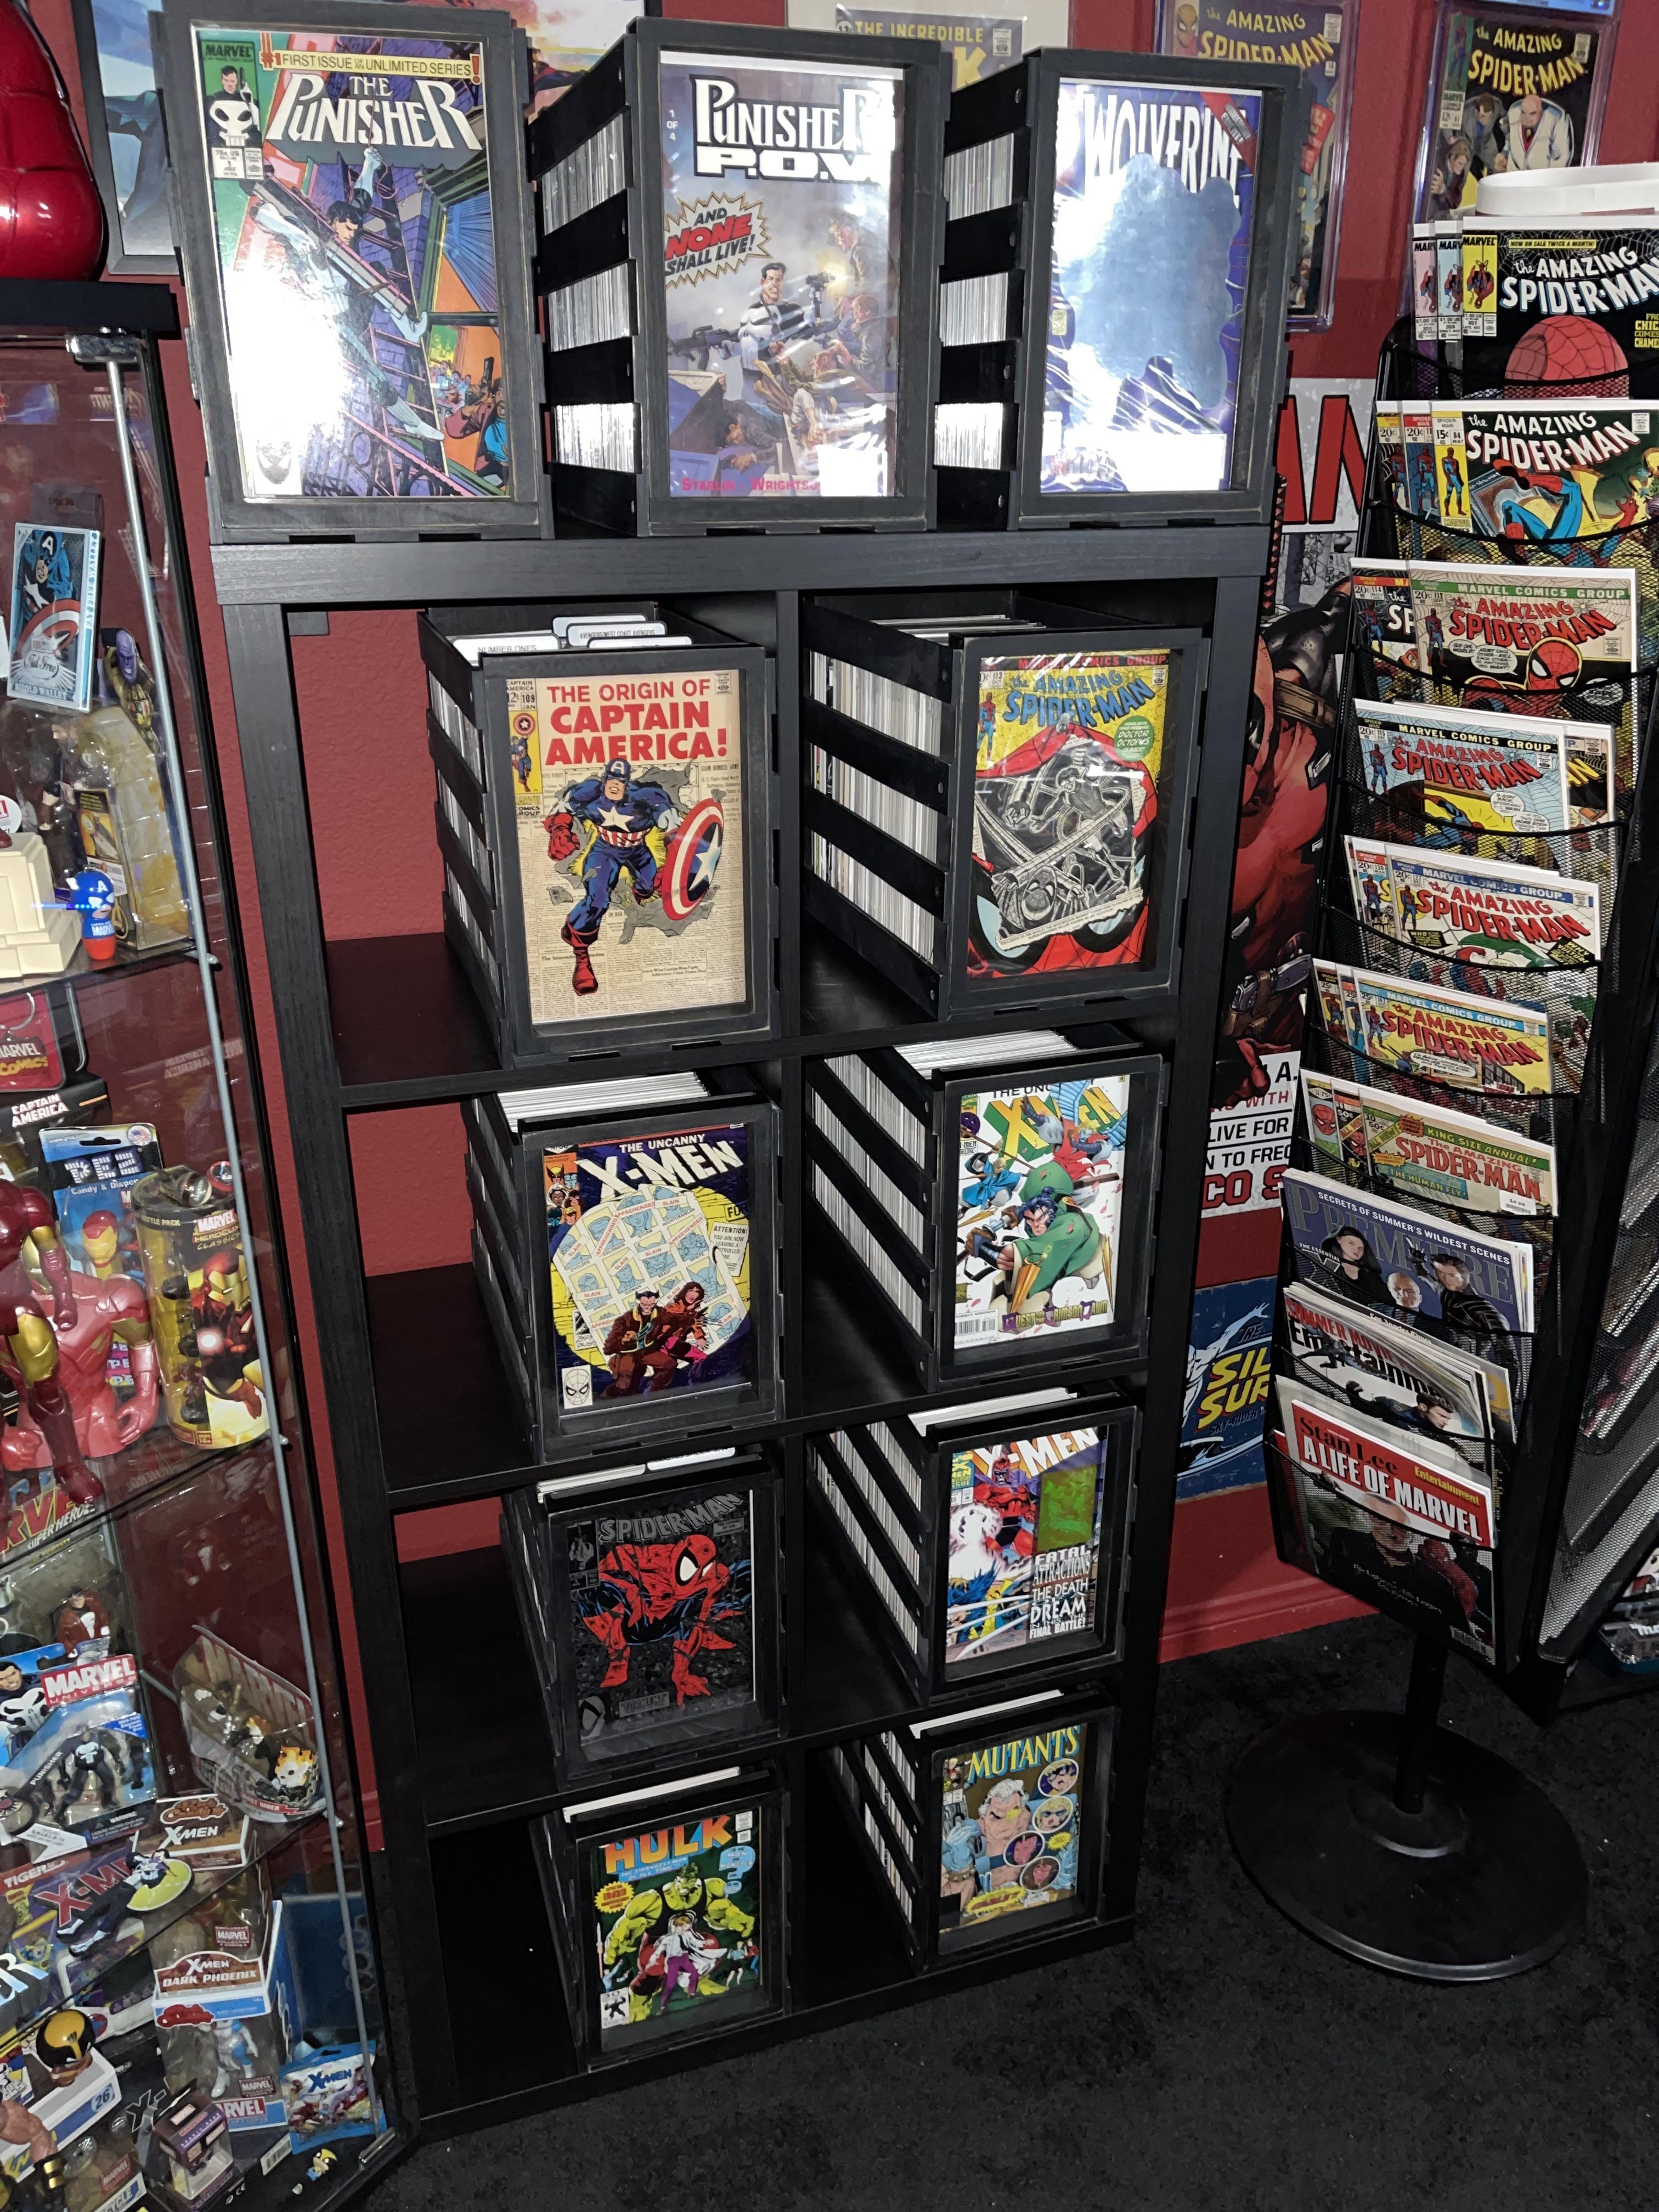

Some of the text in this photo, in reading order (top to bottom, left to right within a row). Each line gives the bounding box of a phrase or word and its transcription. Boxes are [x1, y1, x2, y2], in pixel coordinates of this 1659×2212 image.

[890, 21, 983, 43] INCREDIBLE
[1226, 9, 1306, 33] AMAZING
[206, 44, 252, 58] MARVEL
[1493, 28, 1562, 54] AMAZING
[282, 55, 317, 67] FIRST
[318, 57, 352, 69] ISSUE
[365, 59, 427, 74] UNLIMITED
[1468, 49, 1585, 96] SPIDER-MAN
[349, 76, 393, 97] THE
[267, 74, 483, 150] PUNISHER
[666, 121, 678, 129] OF
[693, 207, 727, 227] AND
[665, 213, 753, 261] NONE
[1463, 236, 1495, 246] MARVEL
[665, 235, 756, 276] SHALL LIVE!
[1514, 246, 1637, 278] the AMAZING
[1436, 430, 1449, 439] 15¢
[1467, 412, 1597, 435] the AMAZING
[1466, 421, 1641, 472] SPIDER-MAN
[1388, 591, 1407, 602] the
[1458, 584, 1625, 599] MARVEL COMICS GROUP
[1477, 597, 1574, 620] AMAZING
[1448, 609, 1617, 651] SPIDER-MAN
[515, 644, 537, 652] ONES
[1127, 655, 1166, 665] GROUP
[992, 672, 1002, 680] 113
[1034, 670, 1122, 693] AMAZING
[522, 694, 535, 703] 109
[546, 679, 711, 704] THE ORIGIN OF
[1003, 678, 1155, 728] SPIDER-MAN
[550, 701, 710, 735] CAPTAIN
[545, 728, 727, 766] AMERICA!
[1116, 737, 1150, 747] OCTOPUS
[1399, 724, 1446, 739] MARVEL
[1451, 732, 1499, 746] COMICS
[1507, 739, 1552, 752] GROUP
[1416, 738, 1504, 763] AMAZING
[1392, 747, 1543, 790] SPIDER-MAN
[1423, 868, 1468, 885] MARVEL
[1520, 886, 1564, 900] GROUP
[1428, 881, 1554, 915] the AMAZING
[1416, 890, 1591, 944] SPIDER-MAN
[1387, 992, 1515, 1028] MARVEL COMICS GROUP
[1413, 1009, 1508, 1042] AMAZING
[1382, 1010, 1543, 1066] SPIDER-MAN
[0, 1056, 48, 1076] COMICS
[991, 1086, 1022, 1098] THE
[1245, 1090, 1289, 1108] WITH
[11, 1093, 61, 1115] CAPTAIN
[12, 1102, 69, 1127] AMERICA
[1253, 1116, 1289, 1137] FOR
[619, 1134, 706, 1154] THE UNCANNY
[1427, 1128, 1538, 1165] KING SIZE ANNUAL!
[1428, 1138, 1522, 1172] The AMAZING
[64, 1152, 139, 1184] PEZ
[1222, 1151, 1245, 1168] TO
[1395, 1136, 1541, 1201] SPIDER-MAN
[573, 1141, 744, 1203] X-MEN
[1390, 1169, 1443, 1191] THE HUMAN
[71, 1185, 98, 1195] Candy
[614, 1201, 656, 1217] APPREHENDED
[596, 1218, 618, 1256] APPREHENDED
[669, 1216, 703, 1246] APPREHENDED
[713, 1226, 748, 1234] ATTENTION!
[1318, 1192, 1510, 1265] SECRETS OF SUMMER'S WILDEST SCENES
[568, 1243, 582, 1257] SLAIN
[645, 1248, 662, 1256] SLAIN
[1311, 1245, 1341, 1262] ESSENTIAL
[614, 1256, 629, 1271] SLAIN
[666, 1286, 681, 1300] SLAIN
[1238, 1322, 1263, 1343] THE
[1300, 1417, 1398, 1476] Stan Lee
[1304, 1436, 1482, 1542] A LIFE OF MARVEL
[1414, 1466, 1480, 1506] Entertainment
[599, 1493, 743, 1542] SPIDER-MAN
[1035, 1544, 1091, 1565] FATAL
[1033, 1555, 1091, 1585] ATTRACTIONS
[1032, 1578, 1089, 1602] THE DEATH
[1030, 1596, 1086, 1624] DREAM
[1030, 1617, 1086, 1639] FINAL BATTLE!
[45, 1657, 136, 1699] MARVEL
[967, 1724, 1081, 1784] MUTANTS
[30, 1751, 64, 1786] PUNISHER
[159, 1826, 218, 1849] X-MEN
[603, 1814, 733, 1874] HULK
[217, 1929, 249, 1941] MARVEL
[187, 1958, 229, 1974] X-MEN
[163, 1970, 257, 1987] DARK PHOENIX
[308, 2069, 353, 2092] X-MEN
[95, 2089, 110, 2109] 26
